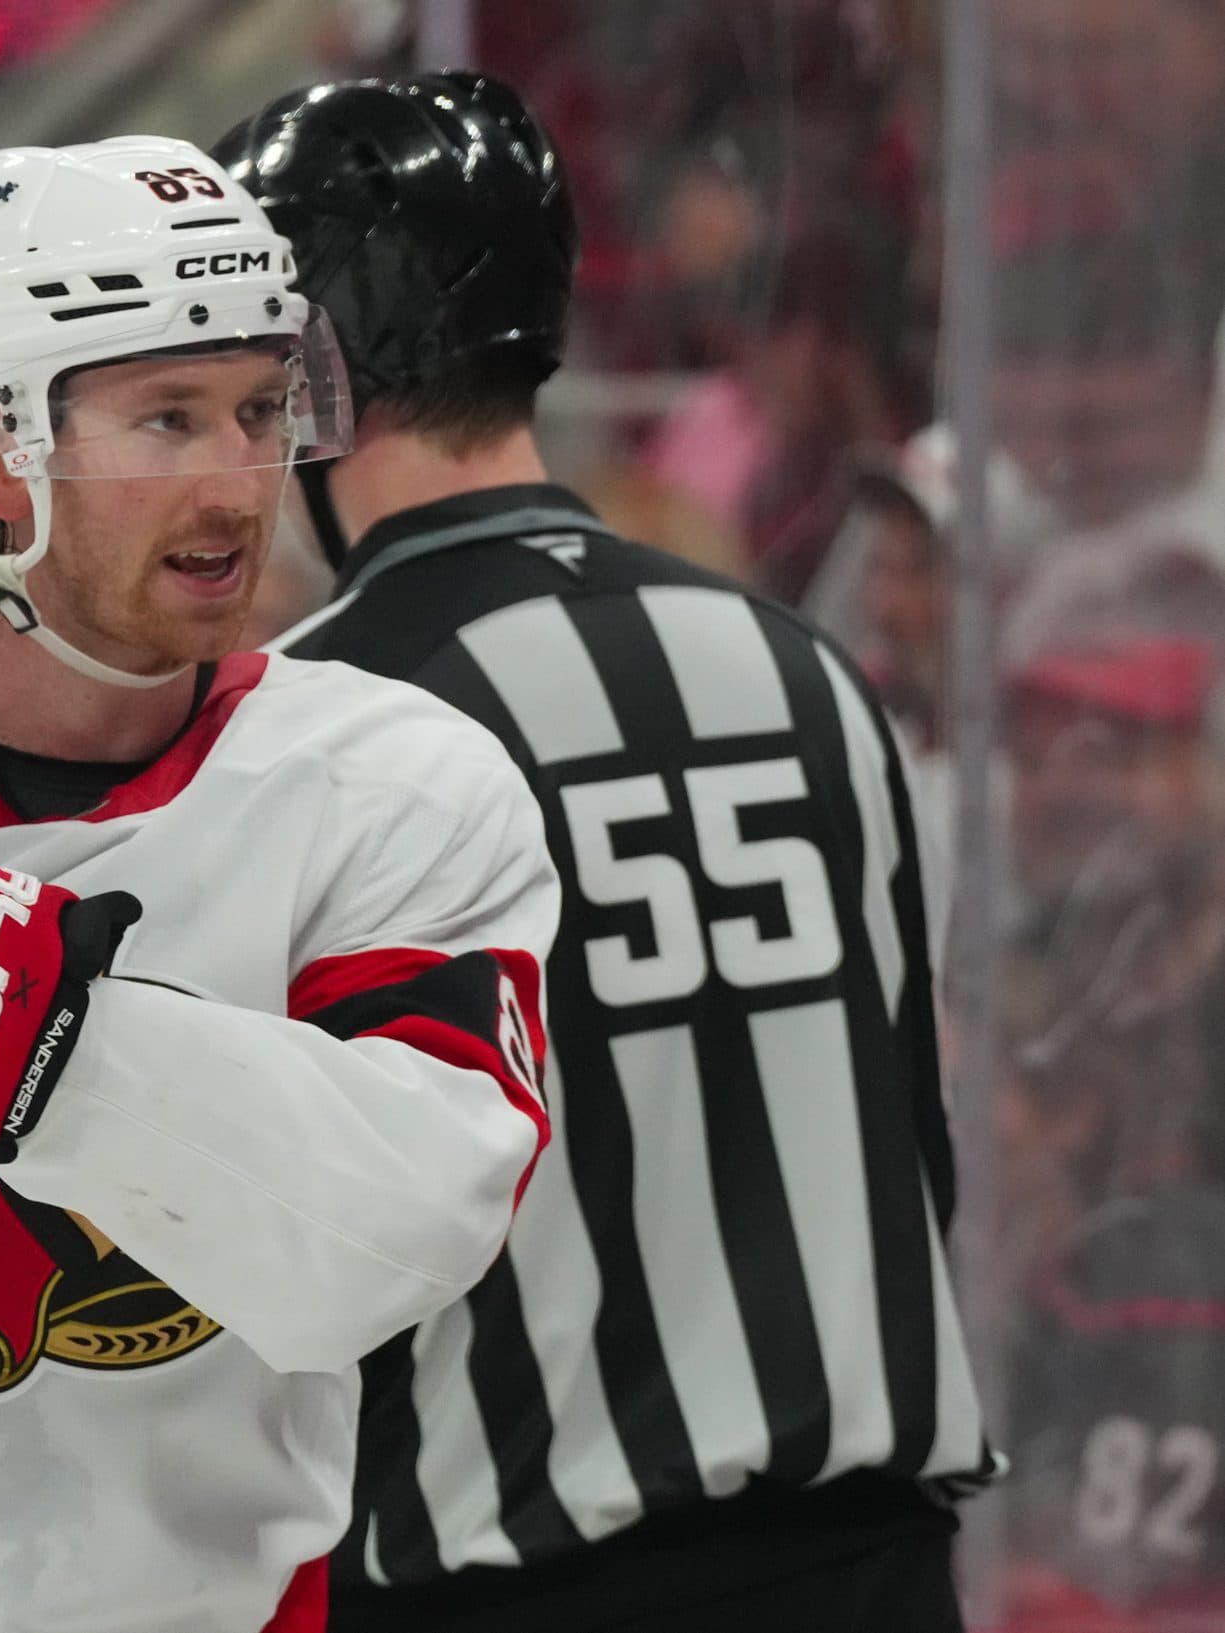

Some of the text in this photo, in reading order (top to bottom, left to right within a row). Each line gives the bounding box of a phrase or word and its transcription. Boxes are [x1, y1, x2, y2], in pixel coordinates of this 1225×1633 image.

[175, 251, 270, 280] CCM
[559, 756, 843, 1008] 55
[3, 1007, 75, 1135] SANDERSON
[1079, 1415, 1218, 1558] 82
